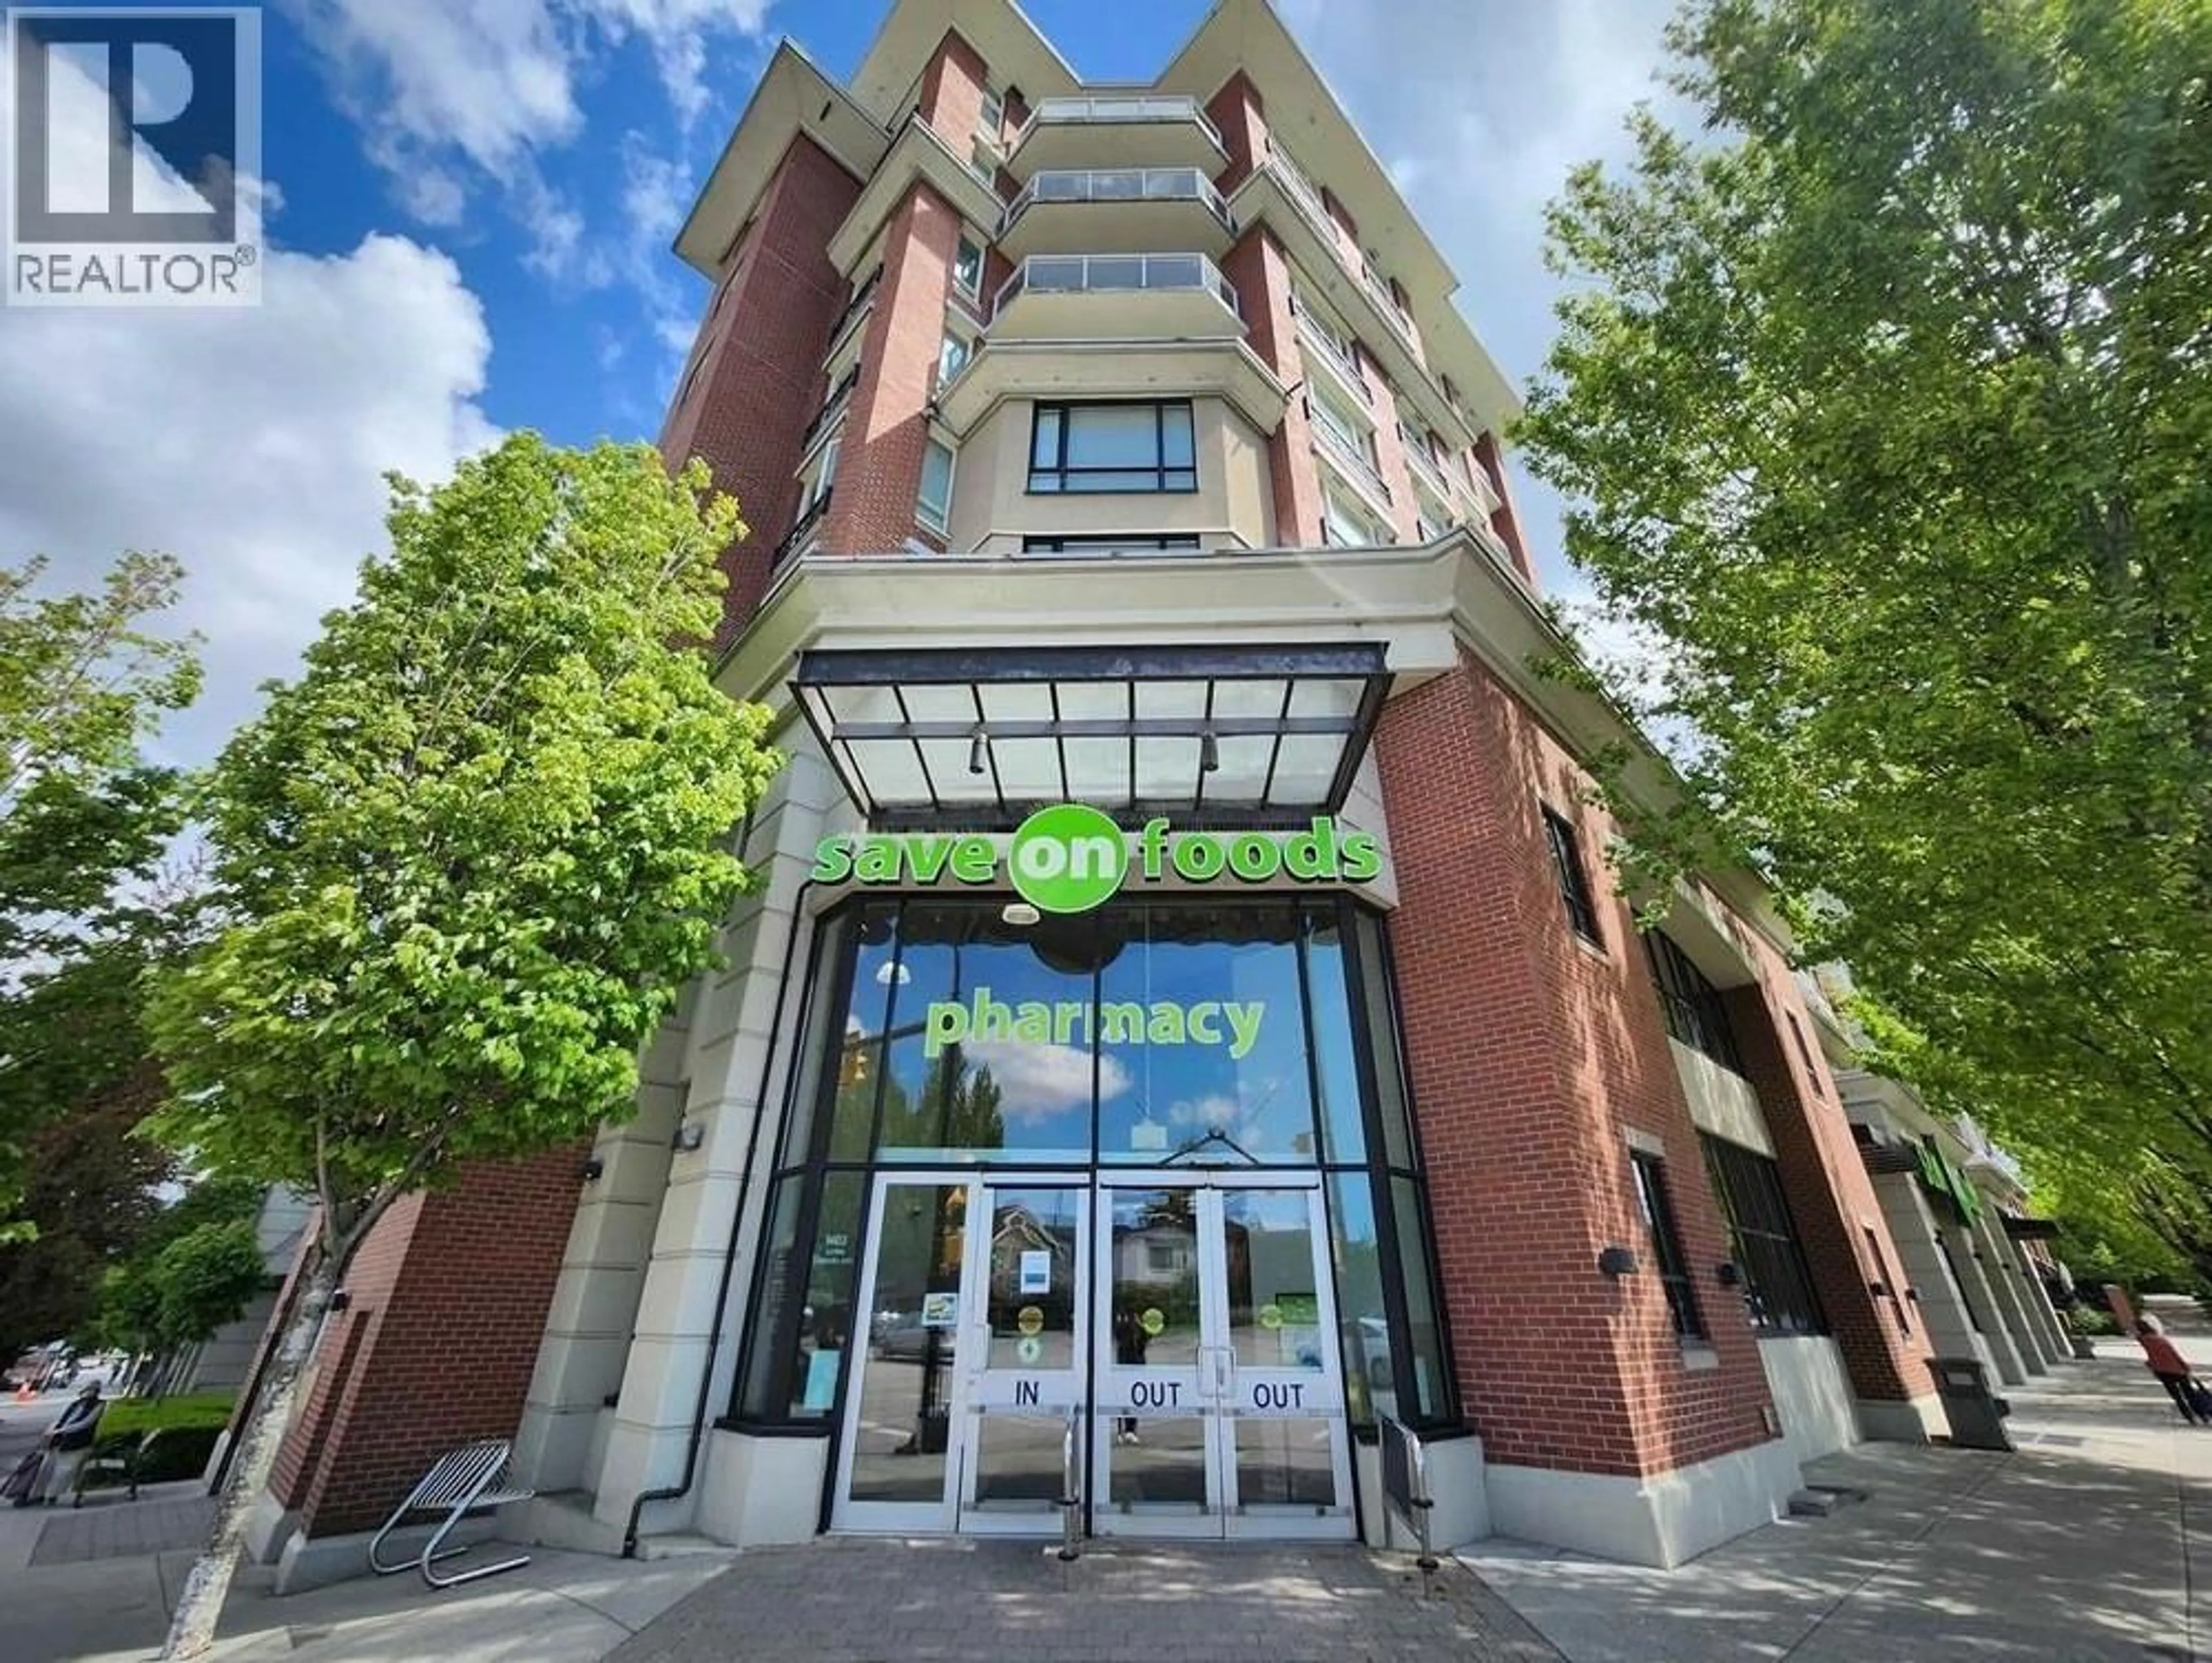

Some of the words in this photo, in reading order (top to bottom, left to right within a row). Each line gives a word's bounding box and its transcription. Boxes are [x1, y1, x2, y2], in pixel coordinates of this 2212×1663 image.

[811, 833, 997, 882] save
[1018, 835, 1117, 879] on
[1139, 816, 1381, 880] foods
[924, 986, 1264, 1059] pharmacy
[1016, 1381, 1039, 1406] IN
[1131, 1381, 1181, 1407] OUT
[1253, 1383, 1303, 1408] OUT
